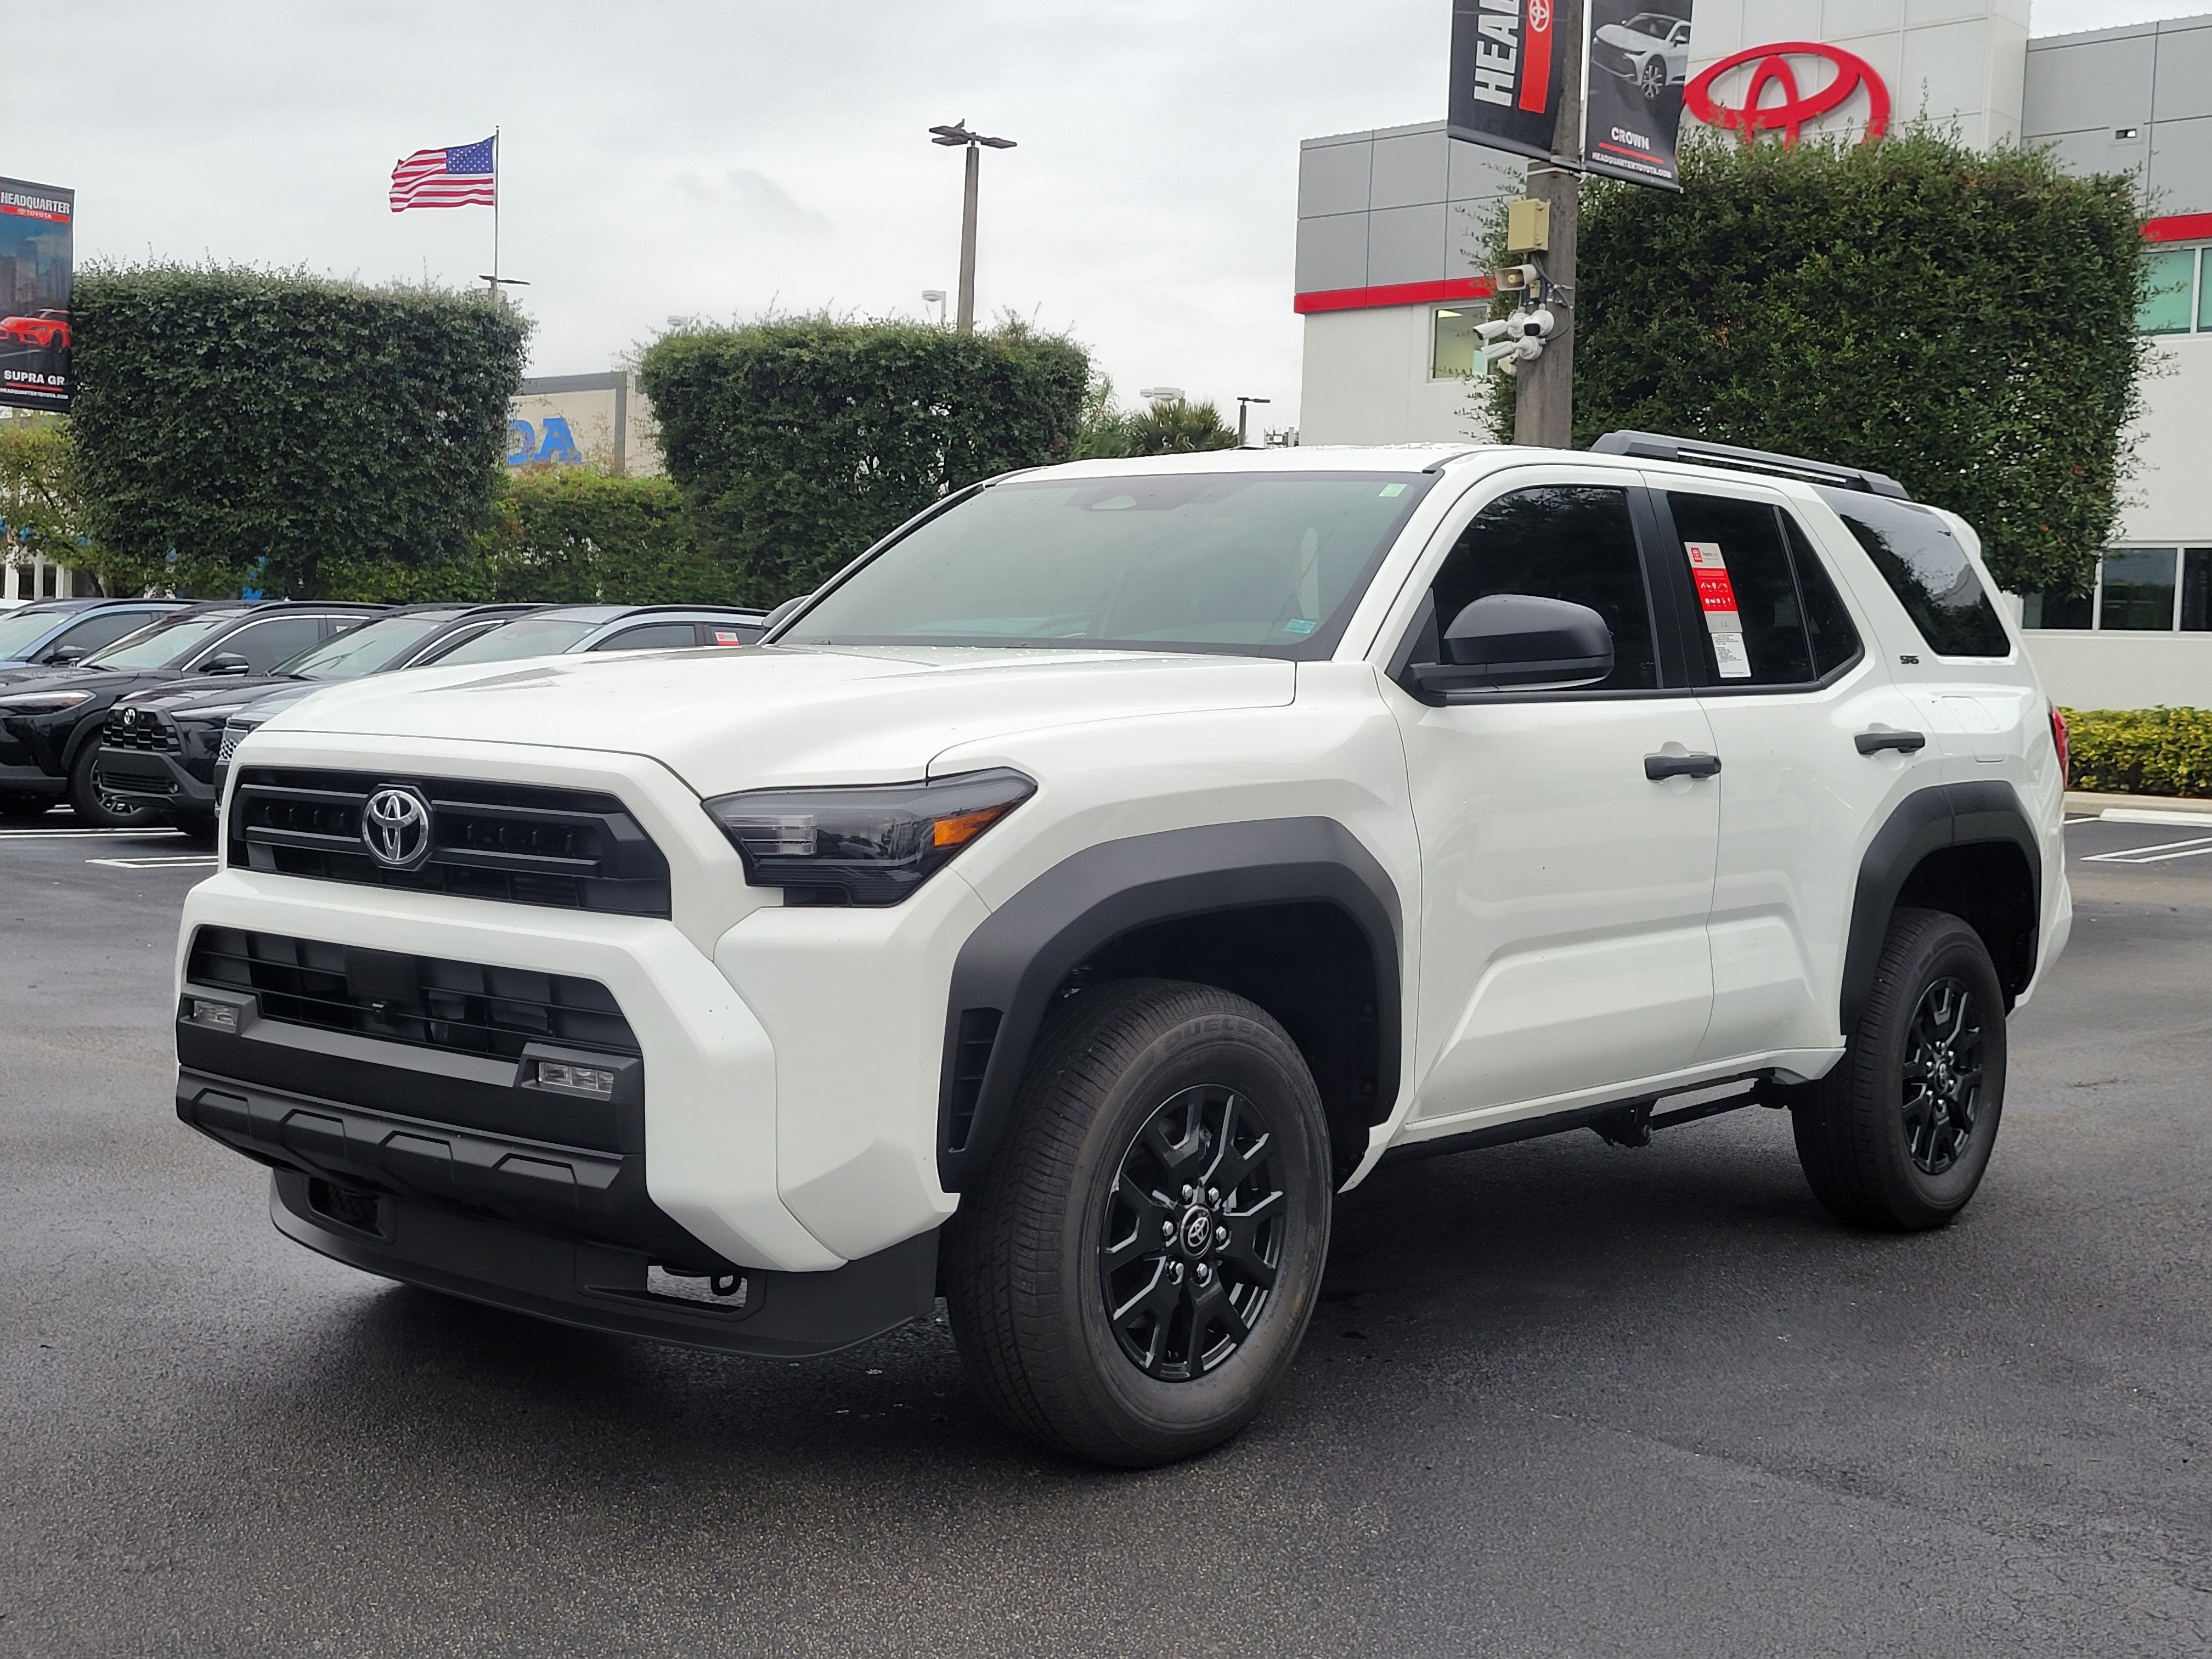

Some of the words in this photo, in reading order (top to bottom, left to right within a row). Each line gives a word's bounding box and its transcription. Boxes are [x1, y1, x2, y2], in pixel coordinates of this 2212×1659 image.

[1611, 127, 1650, 150] CROWN
[1, 191, 70, 214] HEADQUARTER
[27, 210, 52, 219] TOYOTA
[4, 370, 44, 383] SUPRA
[48, 375, 65, 385] GR
